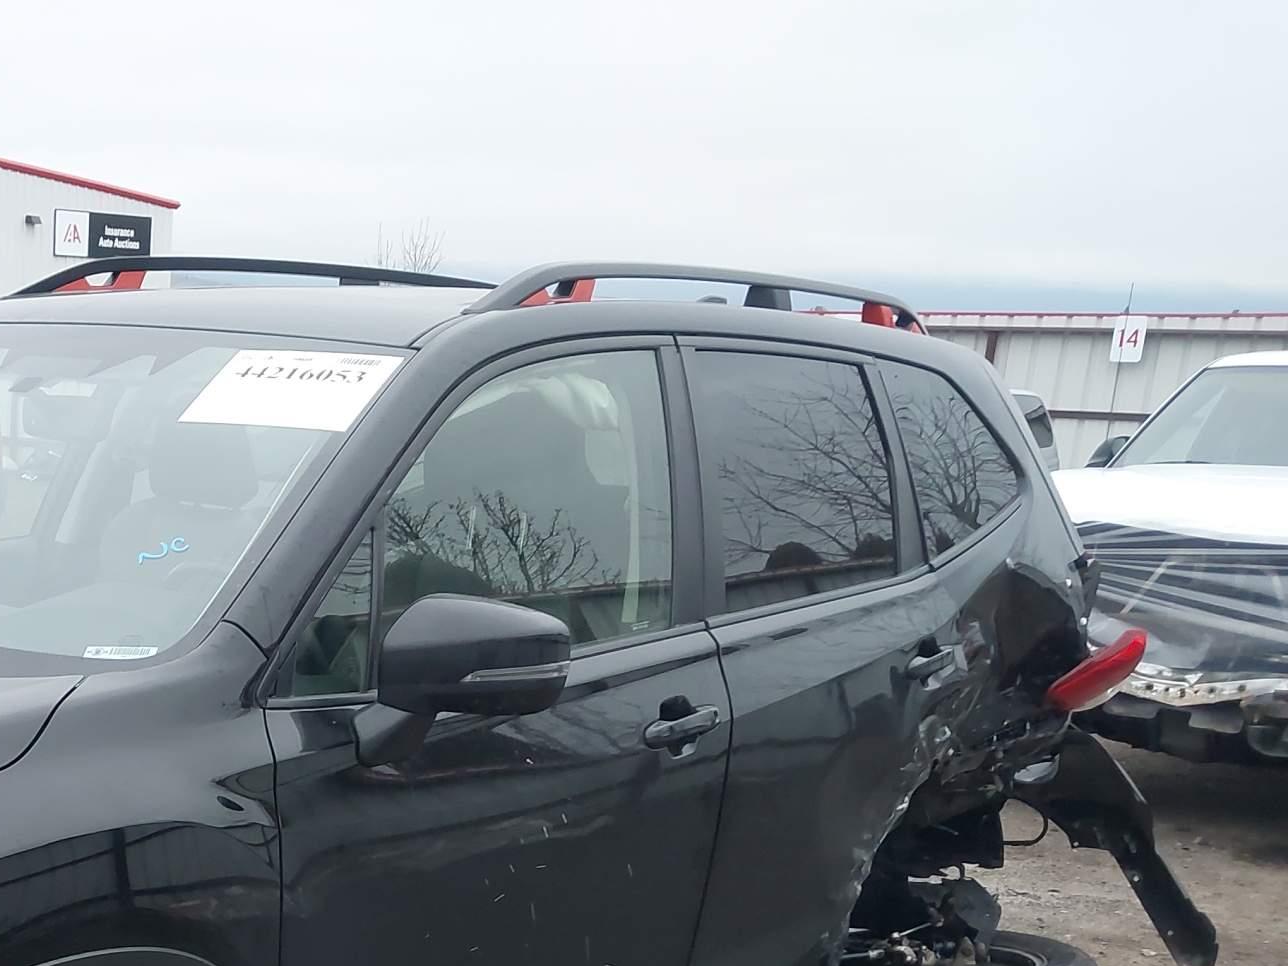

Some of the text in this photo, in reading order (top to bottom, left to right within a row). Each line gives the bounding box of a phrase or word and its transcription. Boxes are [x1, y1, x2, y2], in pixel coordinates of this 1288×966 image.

[104, 225, 135, 237] Insurance
[98, 236, 140, 249] Auto Auctions
[1118, 328, 1139, 348] 14
[235, 365, 367, 384] 44216053
